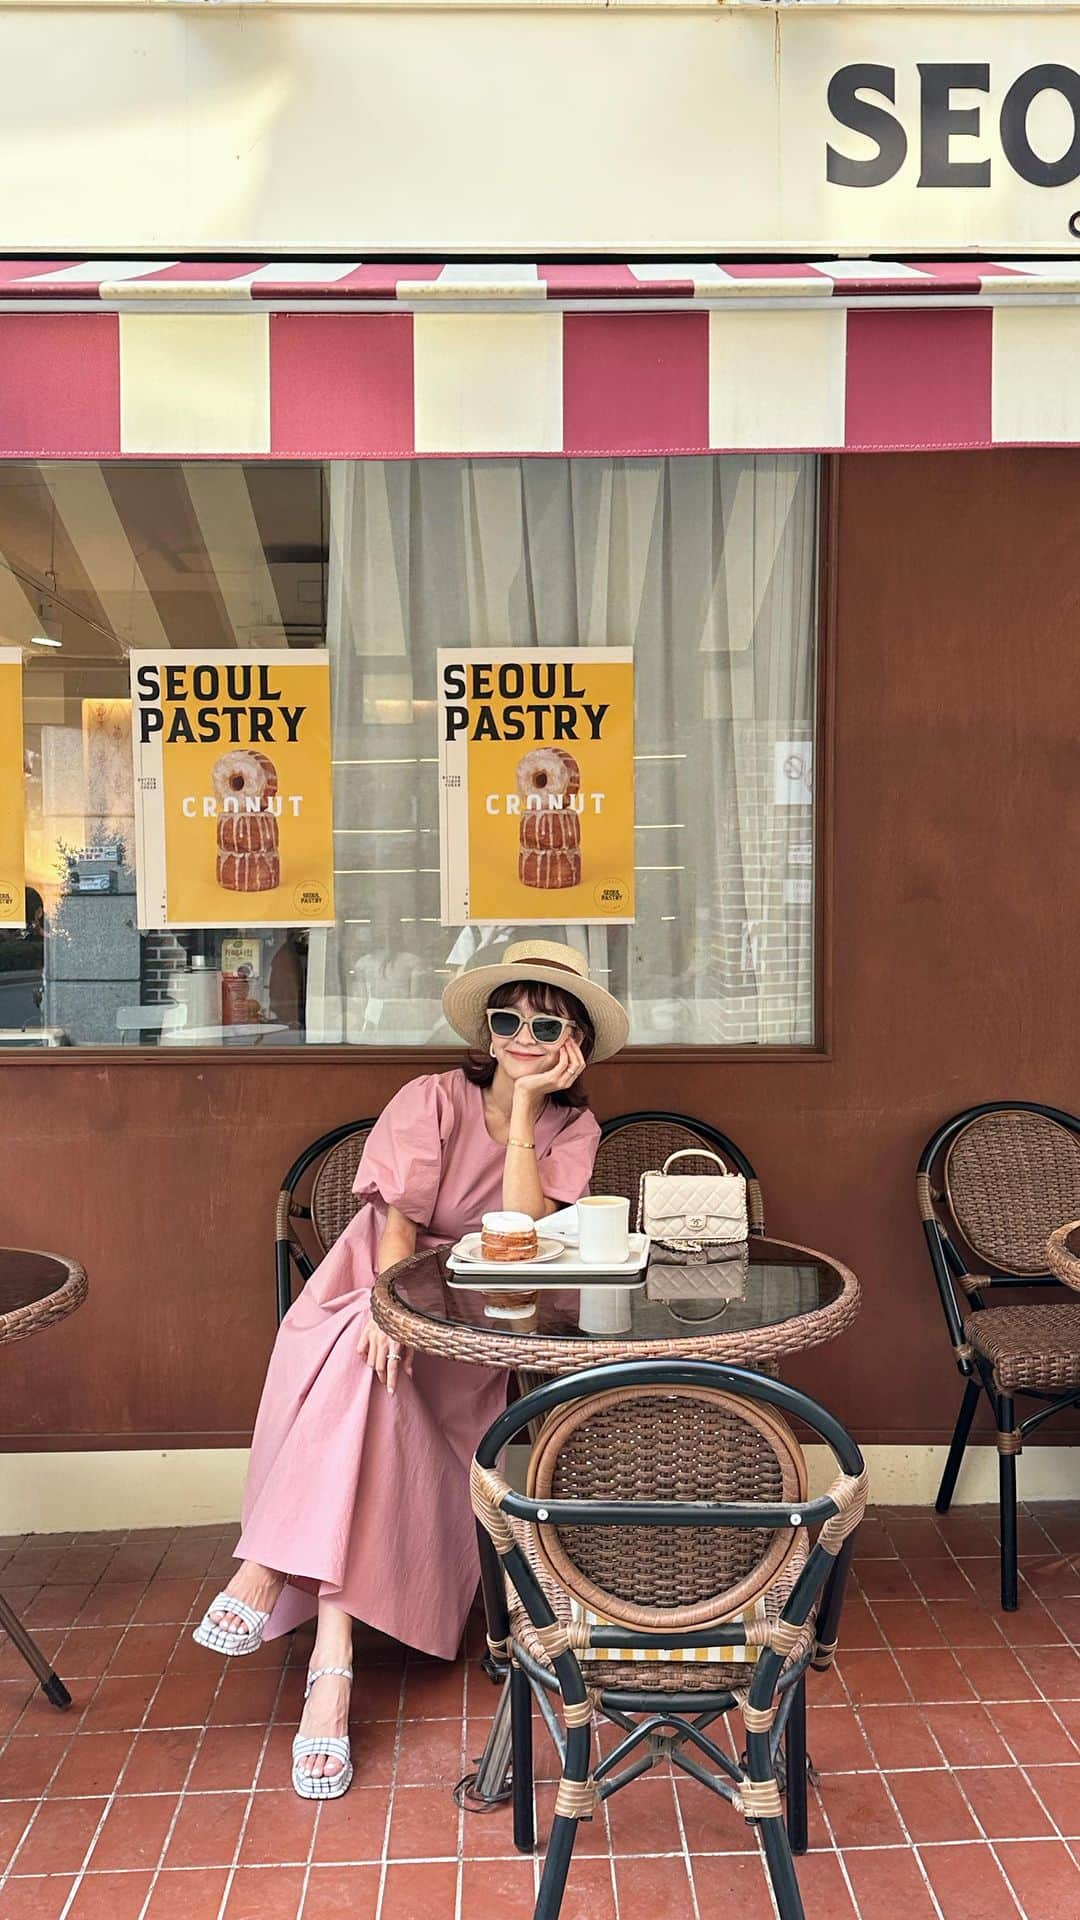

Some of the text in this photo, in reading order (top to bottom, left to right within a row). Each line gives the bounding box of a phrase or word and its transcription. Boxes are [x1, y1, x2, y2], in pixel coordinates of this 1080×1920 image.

[826, 63, 1080, 188] SEO
[137, 665, 282, 701] SEOUL
[443, 663, 586, 699] SEOUL
[139, 707, 307, 743] PASTRY
[445, 704, 610, 741] PASTRY
[182, 795, 304, 818] CRONUT
[485, 793, 606, 815] CRONUT
